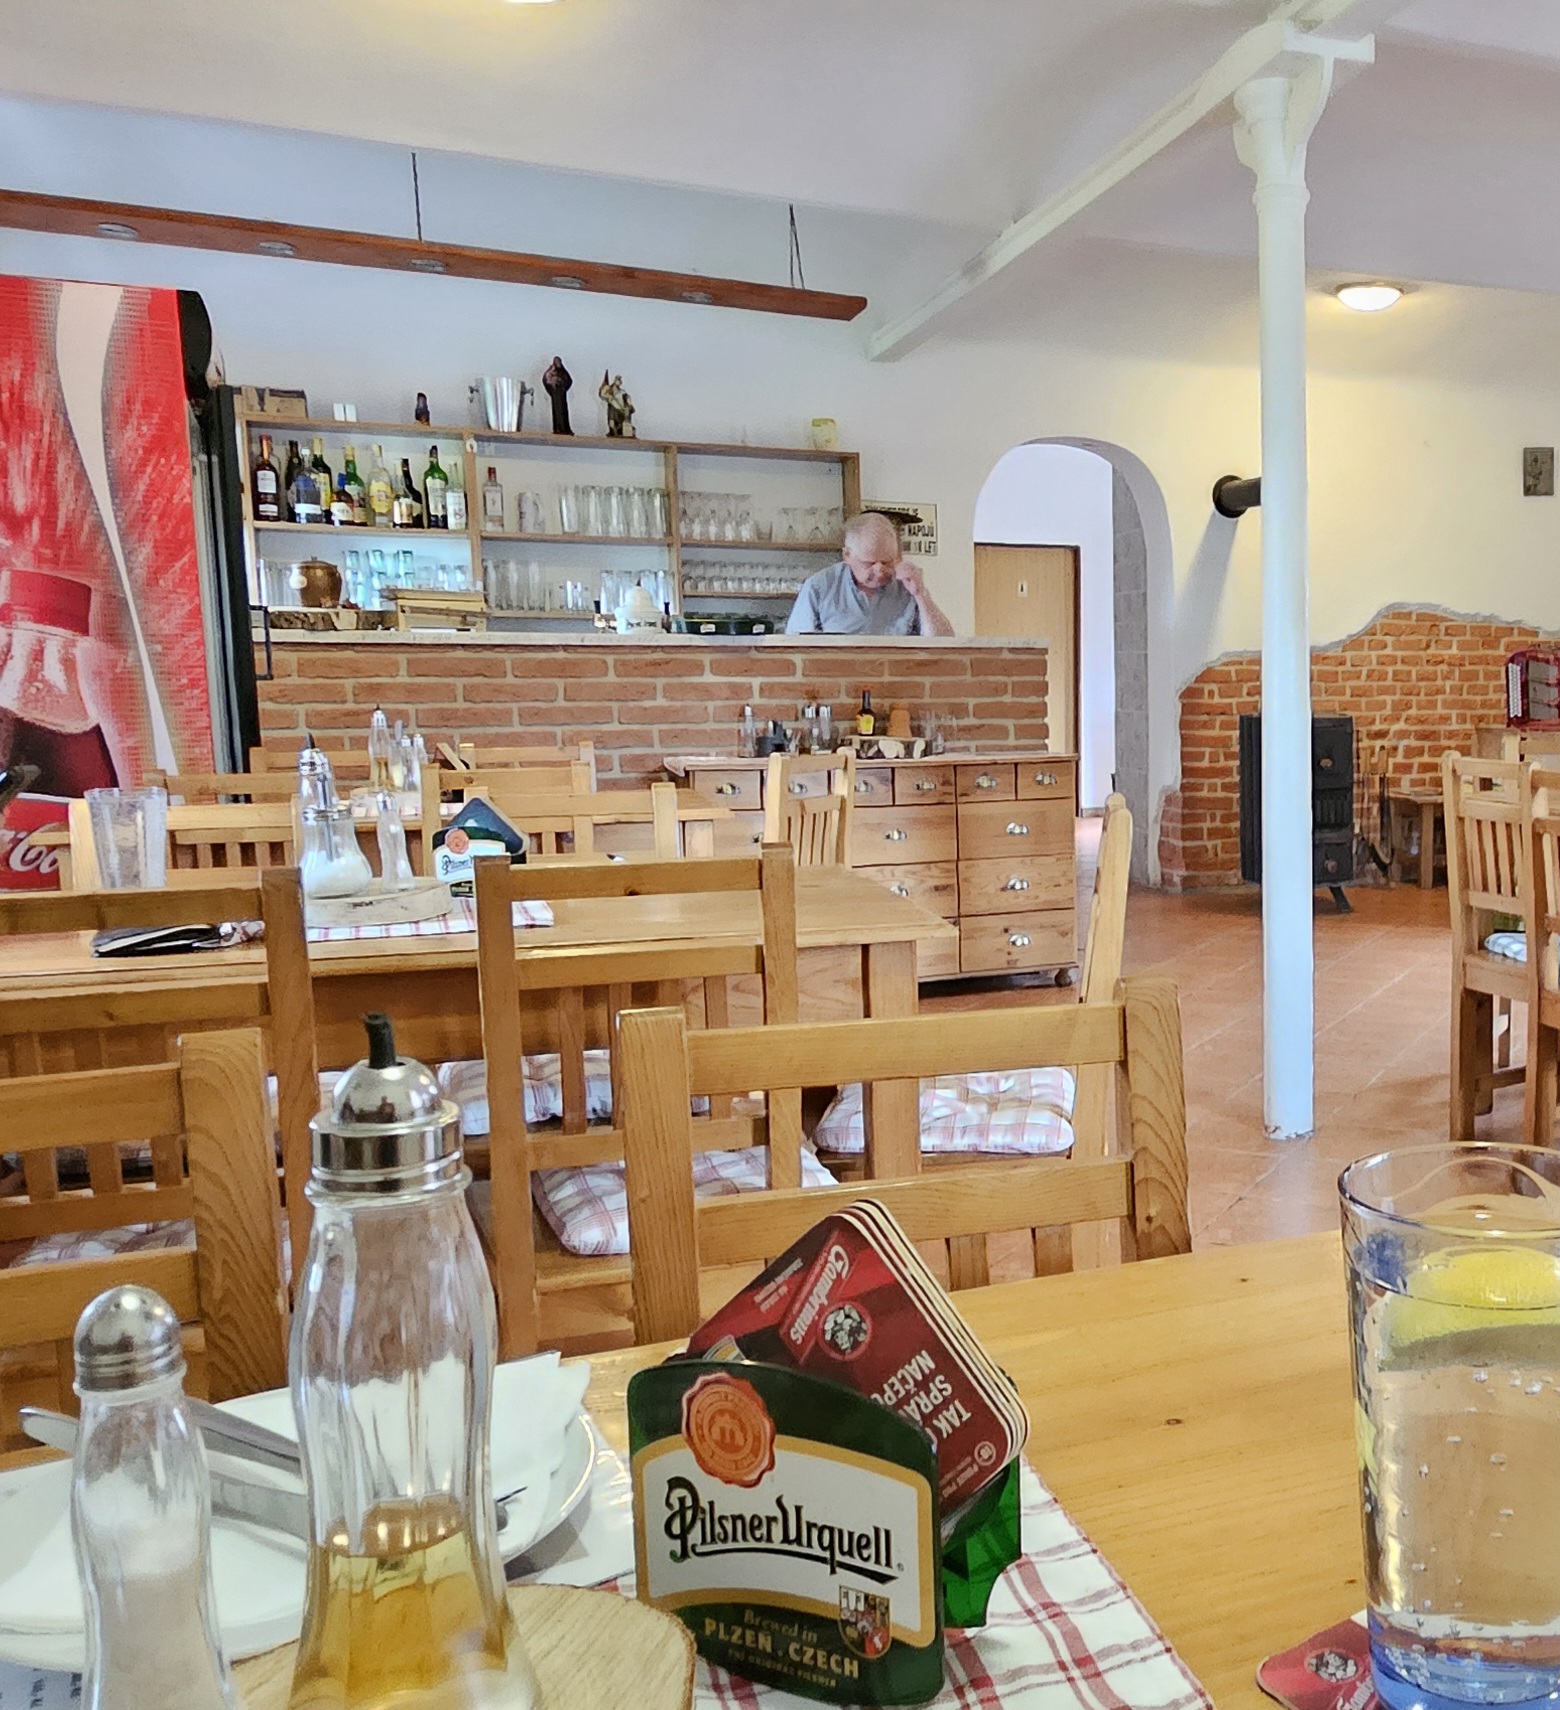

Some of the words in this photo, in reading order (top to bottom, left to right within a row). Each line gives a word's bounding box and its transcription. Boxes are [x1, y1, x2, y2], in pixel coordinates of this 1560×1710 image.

[790, 1245, 850, 1345] Gambrinus
[932, 1399, 972, 1439] TAK
[664, 1476, 778, 1563] Pilsner
[775, 1494, 894, 1575] Urquell
[744, 1609, 798, 1638] Brewed
[802, 1625, 818, 1643] in
[788, 1641, 859, 1679] CZECH
